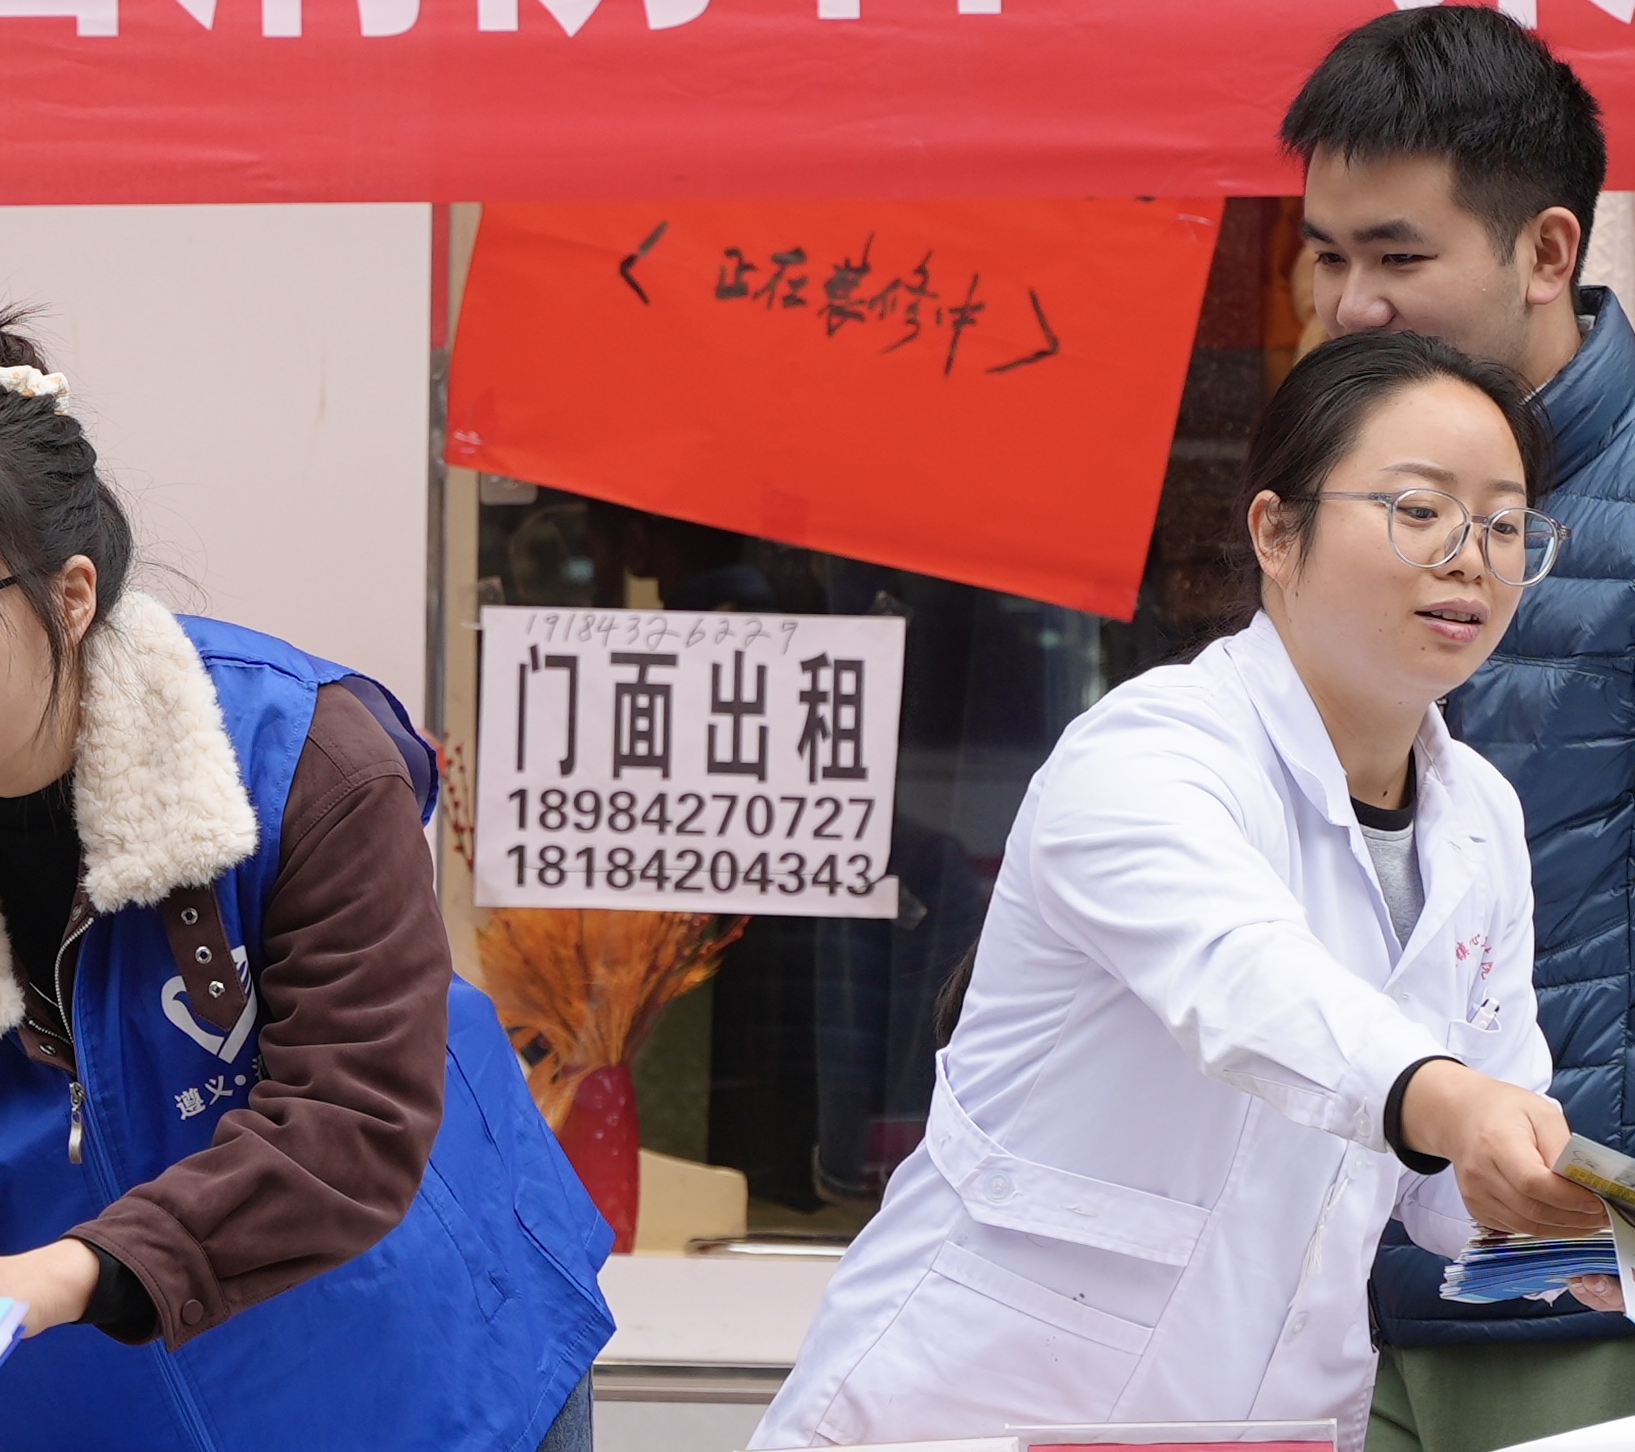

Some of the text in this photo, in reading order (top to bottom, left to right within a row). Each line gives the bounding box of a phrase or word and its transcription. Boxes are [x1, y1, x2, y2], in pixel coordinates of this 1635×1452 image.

[516, 644, 869, 785] 门面出租
[508, 788, 876, 841] 18984270727
[506, 844, 876, 897] 18184204343
